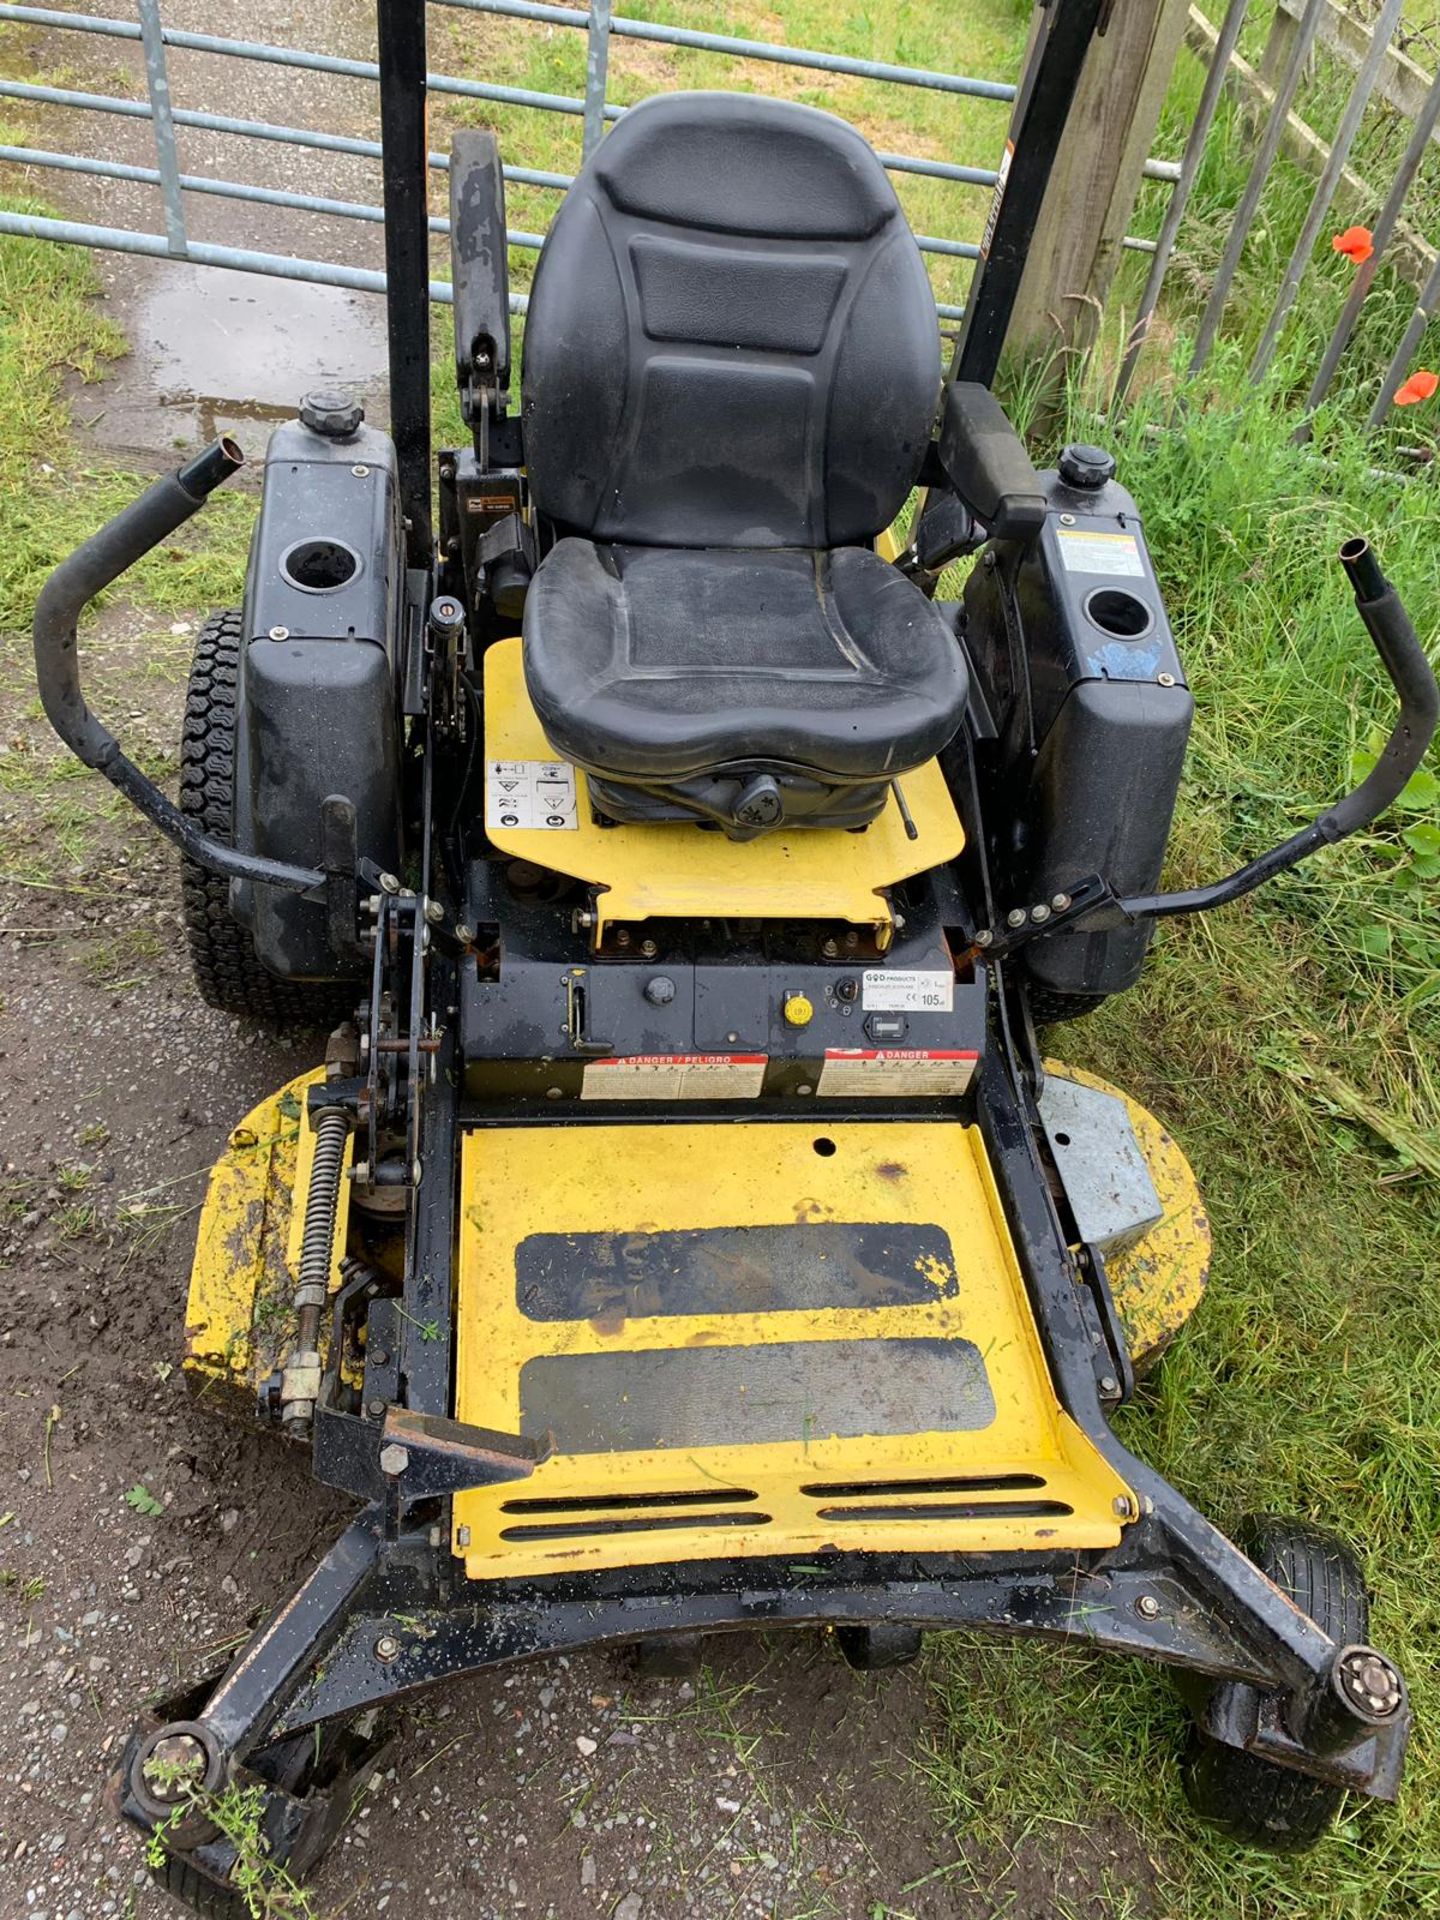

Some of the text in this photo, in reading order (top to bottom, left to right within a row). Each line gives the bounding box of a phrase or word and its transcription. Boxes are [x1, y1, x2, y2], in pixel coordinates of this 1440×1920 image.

[922, 994, 939, 1006] 105
[887, 1051, 929, 1059] DANGER
[629, 1056, 673, 1064] DANGER
[684, 1056, 731, 1064] PELIGRO
